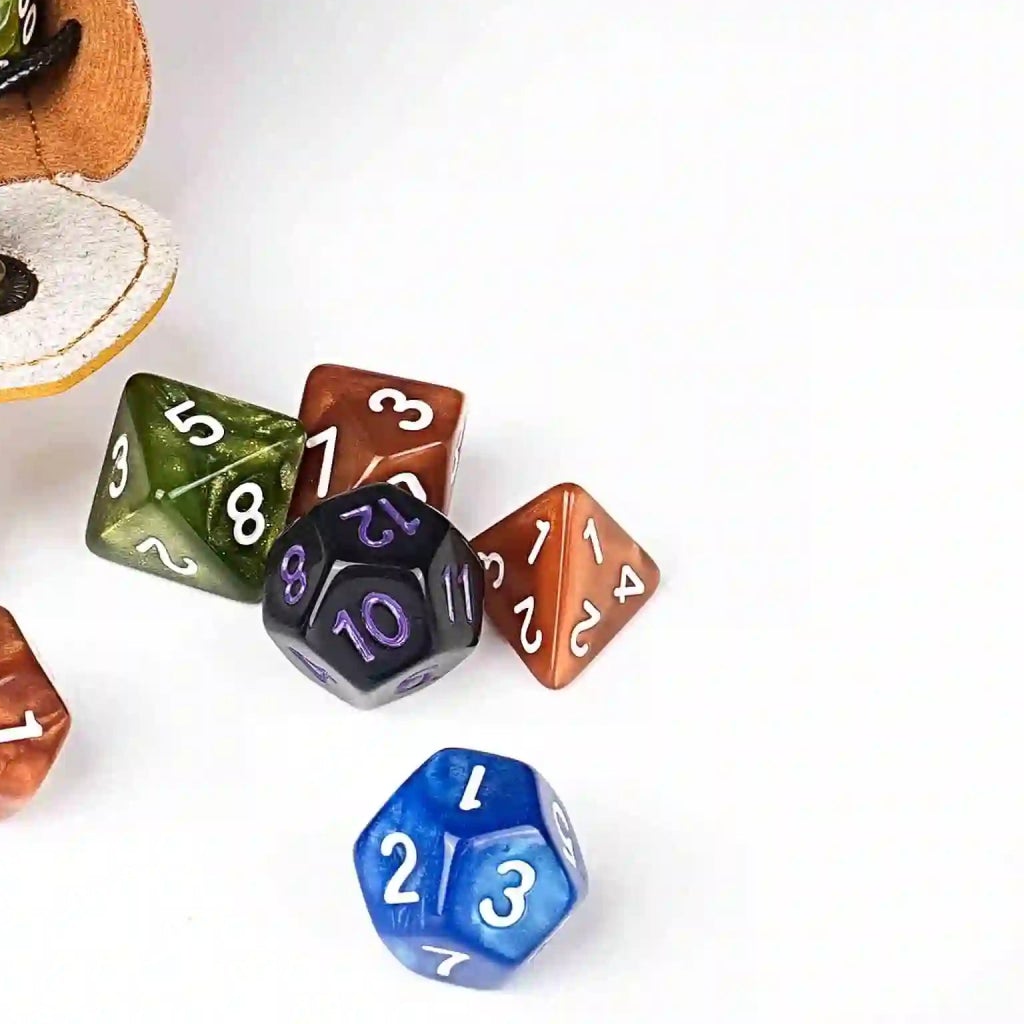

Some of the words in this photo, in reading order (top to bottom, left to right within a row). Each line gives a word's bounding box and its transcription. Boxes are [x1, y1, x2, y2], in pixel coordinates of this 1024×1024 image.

[164, 400, 225, 447] 5
[368, 388, 434, 431] 3
[108, 433, 129, 499] 3
[227, 482, 266, 546] 8
[339, 498, 421, 549] 12
[583, 517, 604, 565] 1
[136, 536, 198, 576] 2
[528, 519, 551, 566] 1
[280, 544, 308, 606] 8
[442, 563, 474, 625] 11
[613, 564, 647, 605] 4
[332, 591, 412, 664] 10
[513, 595, 543, 655] 2
[570, 599, 602, 658] 2
[459, 764, 486, 811] 1
[380, 831, 420, 905] 2
[478, 859, 536, 929] 3
[421, 944, 470, 977] 7
